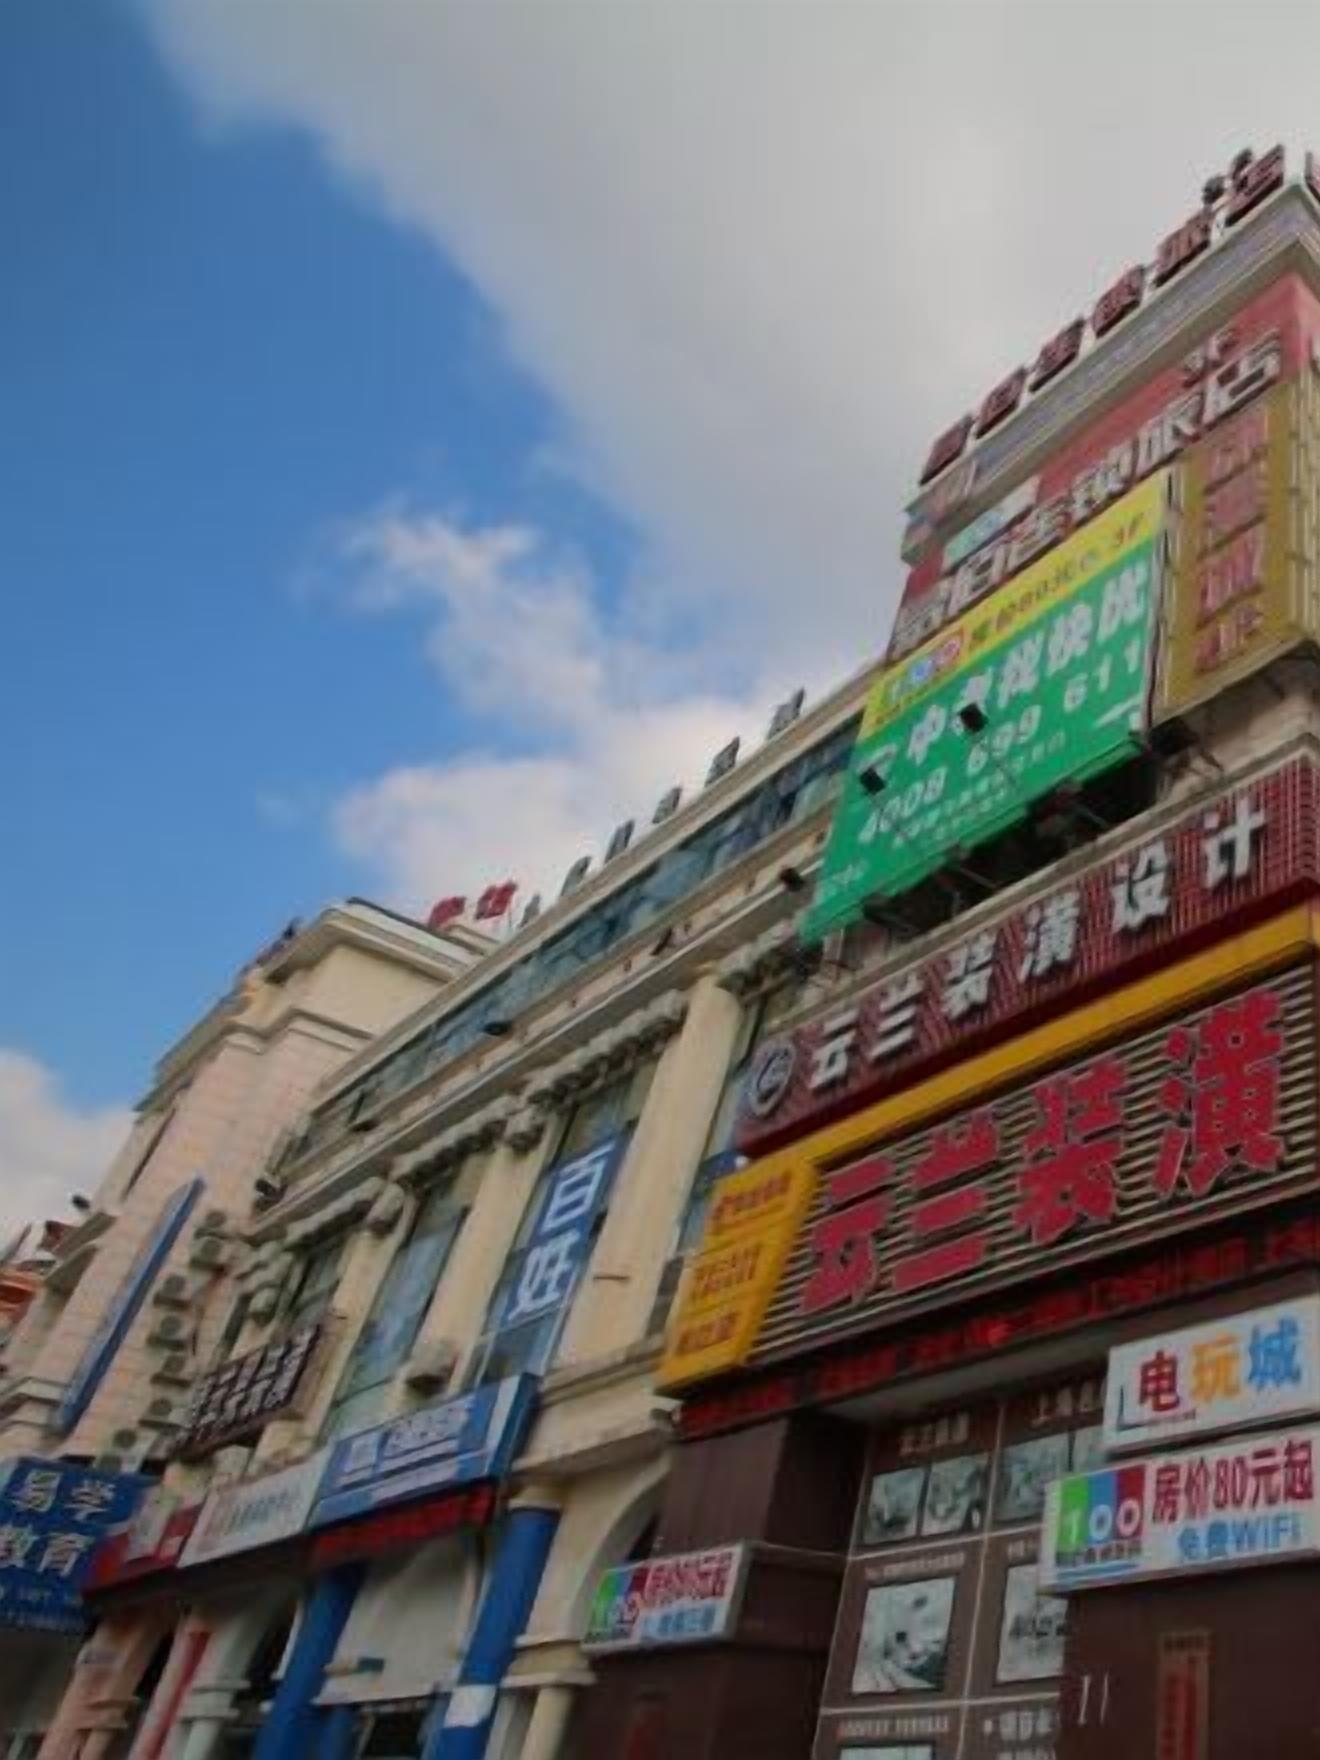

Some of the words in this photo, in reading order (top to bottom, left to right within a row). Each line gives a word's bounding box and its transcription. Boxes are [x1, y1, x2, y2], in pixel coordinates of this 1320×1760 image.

[810, 798, 1265, 1092] 云兰装潢设计
[799, 986, 1284, 1312] 云兰装潢
[1140, 1316, 1302, 1412] 电玩城
[1064, 1498, 1143, 1553] 100
[1152, 1440, 1313, 1524] 房价80元起
